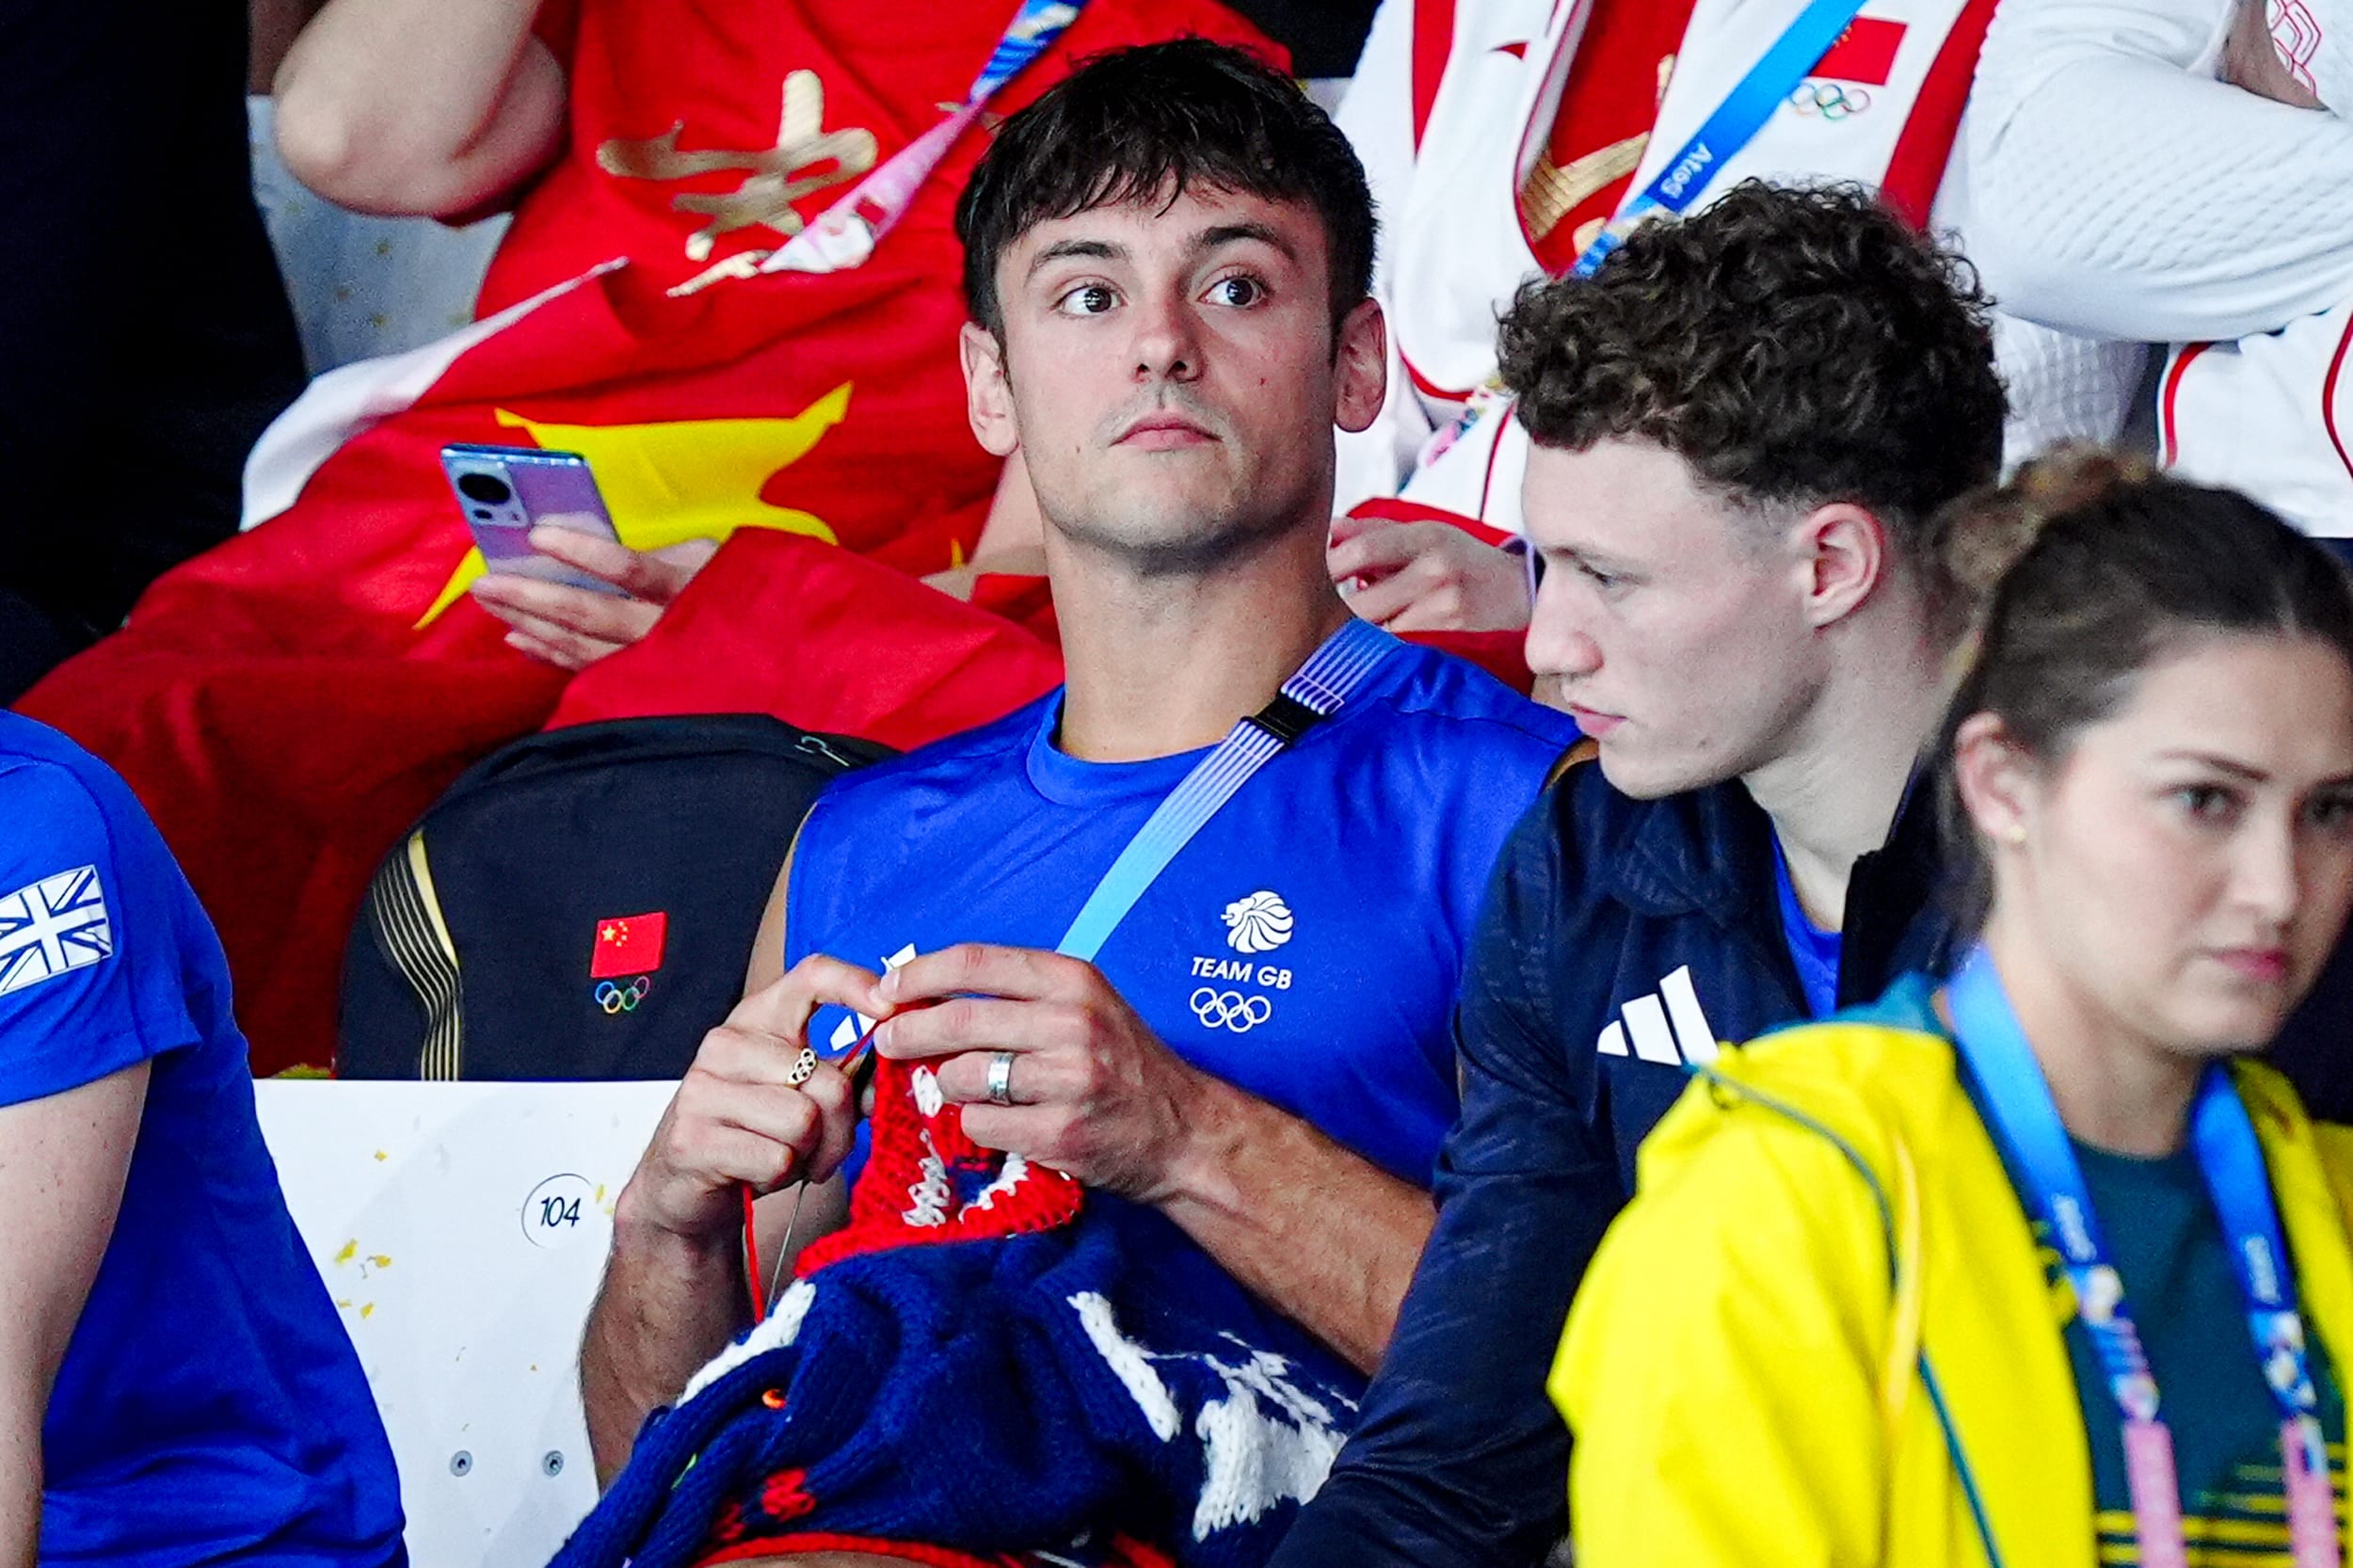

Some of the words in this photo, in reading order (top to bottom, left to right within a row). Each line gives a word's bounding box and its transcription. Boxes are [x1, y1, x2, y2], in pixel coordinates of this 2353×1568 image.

[1659, 141, 1714, 200] Atos
[1191, 956, 1253, 983] TEAM
[1257, 966, 1292, 990] GB
[540, 1196, 581, 1227] 104
